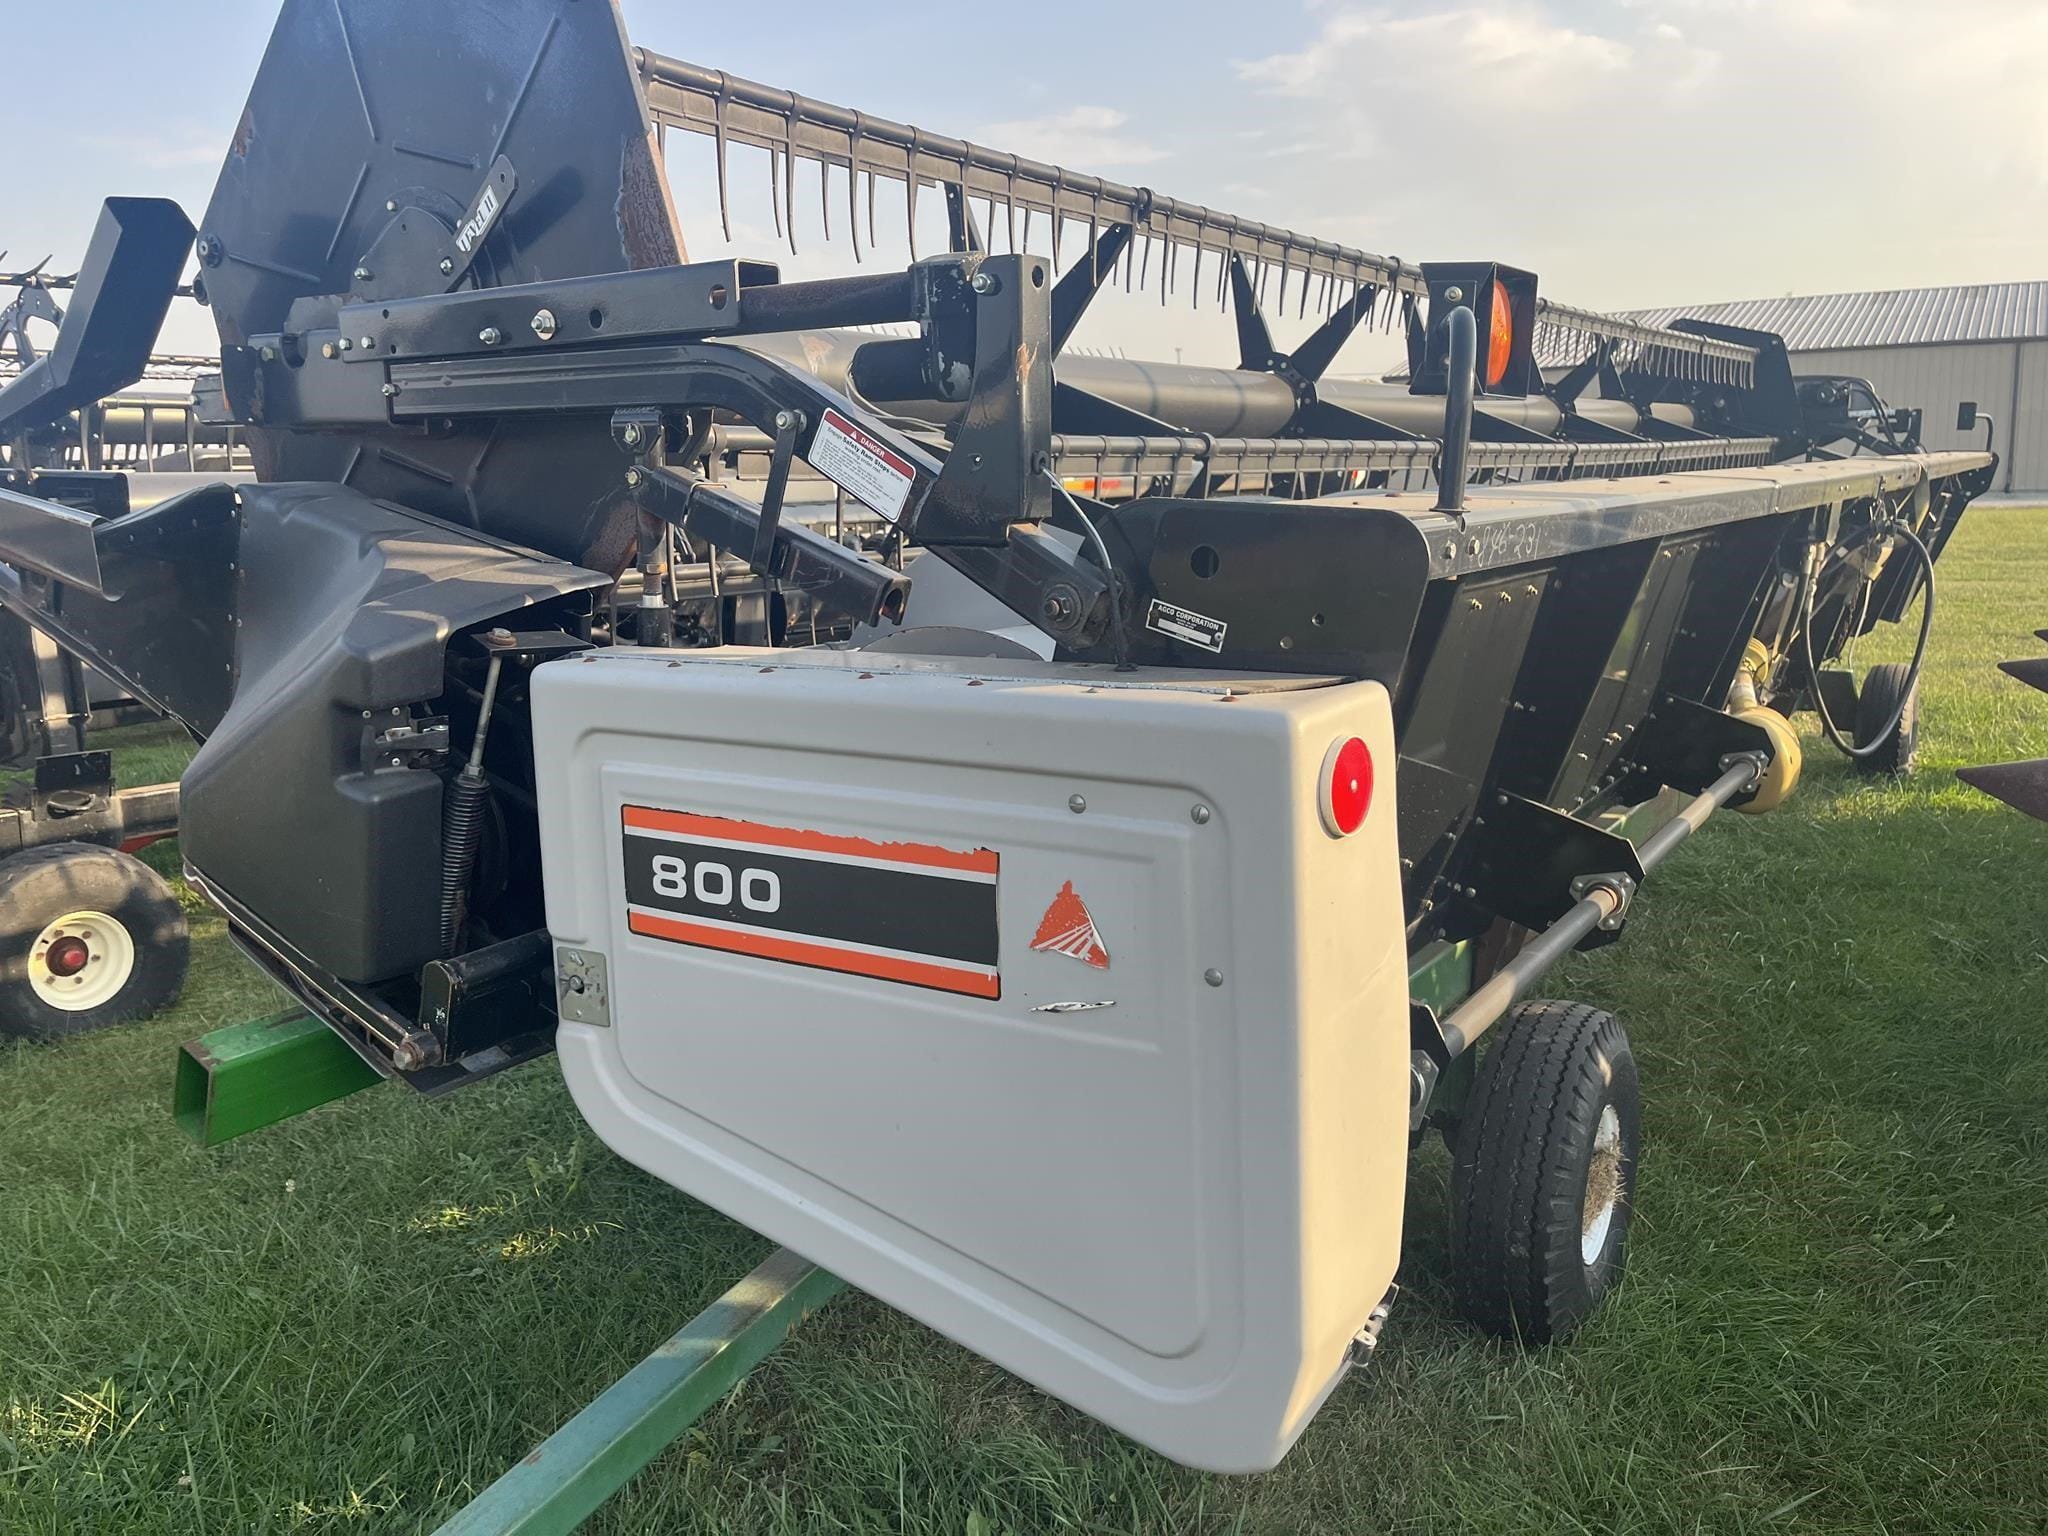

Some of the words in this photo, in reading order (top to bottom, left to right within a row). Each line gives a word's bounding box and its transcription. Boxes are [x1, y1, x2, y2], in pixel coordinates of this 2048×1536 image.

[842, 434, 860, 453] Safety
[860, 449, 874, 462] Ram
[874, 458, 890, 474] Stops
[860, 437, 885, 458] DANGER
[1158, 604, 1175, 616] AGCO
[1175, 610, 1219, 631] CORPORATION
[652, 854, 781, 913] 800
